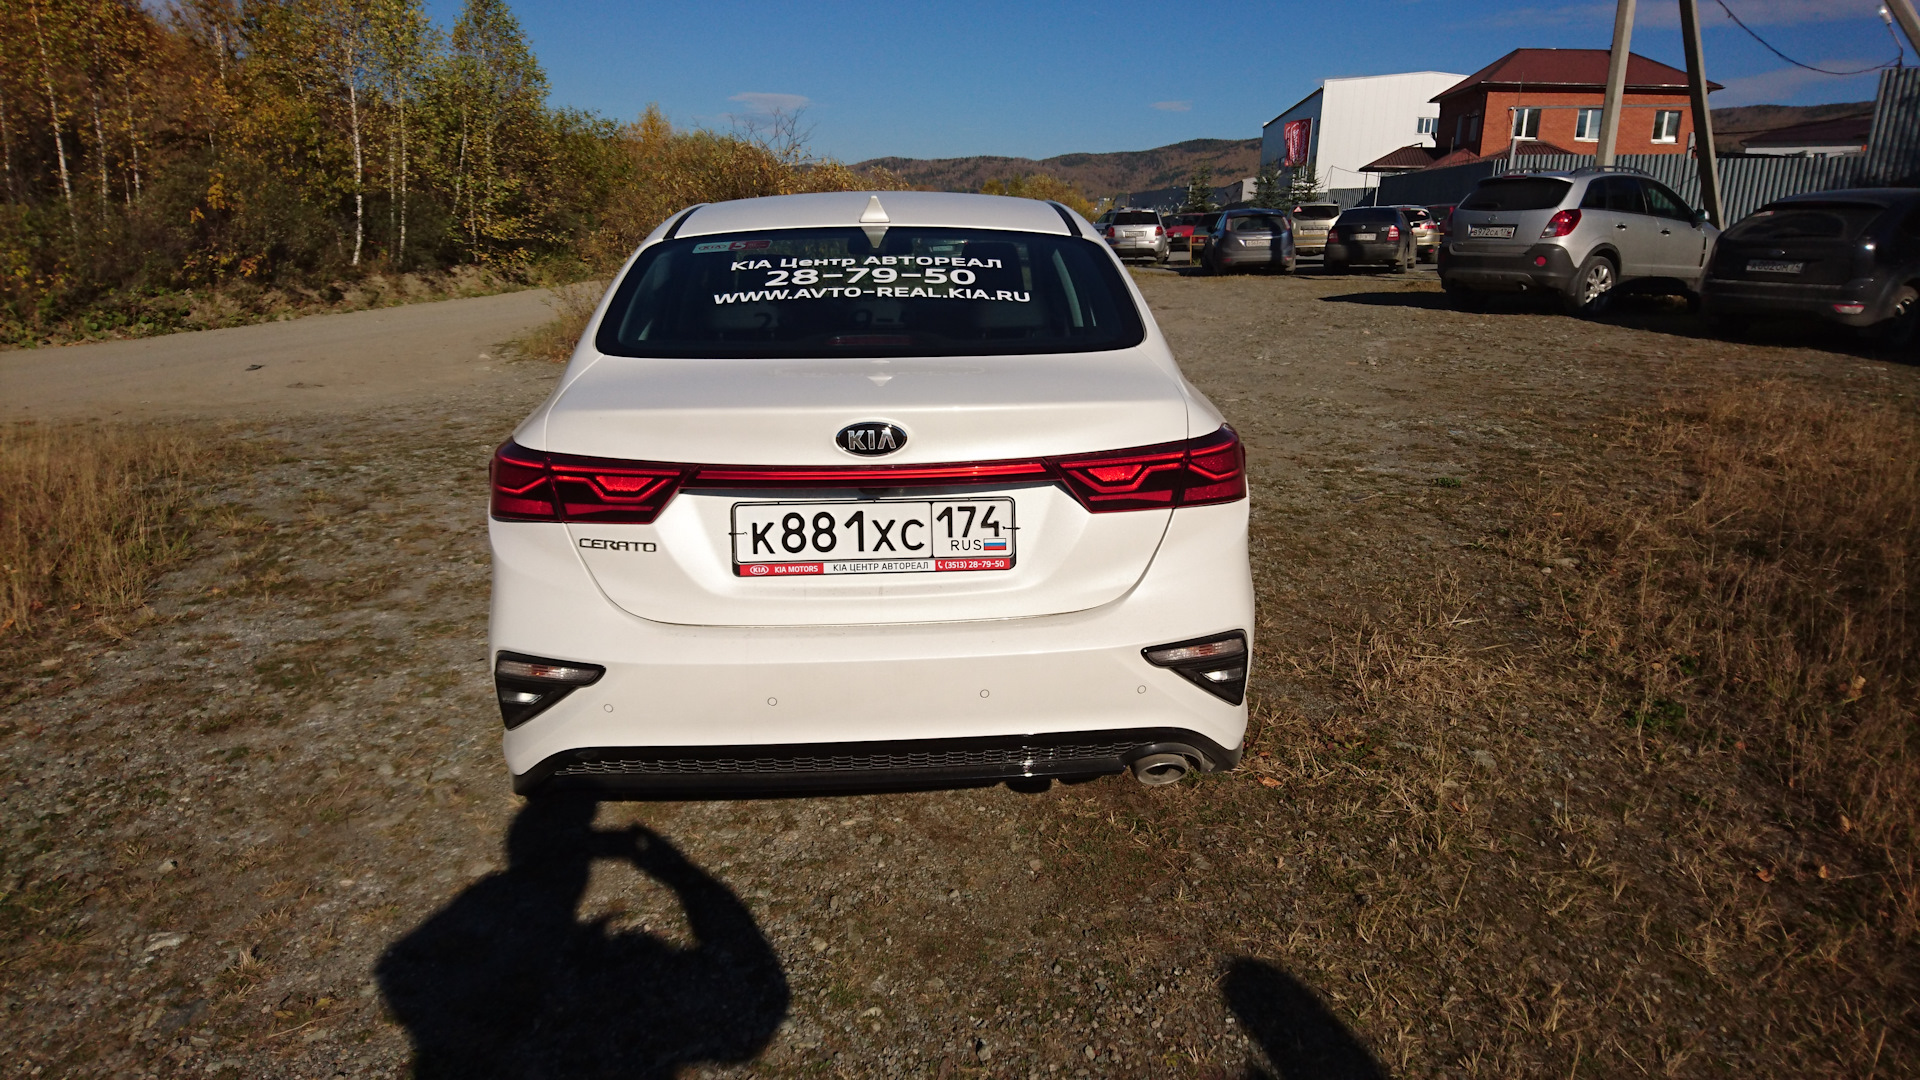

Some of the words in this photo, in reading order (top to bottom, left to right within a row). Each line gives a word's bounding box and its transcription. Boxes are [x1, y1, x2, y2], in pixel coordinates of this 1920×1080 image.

[731, 260, 772, 271] KIA
[780, 258, 856, 268] Центр
[863, 256, 1002, 269] АВТОРЕАЛ
[765, 267, 976, 286] 28-79-50
[714, 287, 1030, 304] WWW.AVTO-REAL.KIA.RU
[848, 429, 897, 450] KIA
[752, 510, 925, 554] К881ХС
[936, 505, 999, 538] 174
[579, 537, 657, 553] CERATO
[950, 540, 982, 551] RUS
[788, 565, 818, 573] MOTORS
[833, 563, 847, 571] KIA
[849, 563, 879, 571] ЦЕНТР
[881, 562, 929, 571] АВТОРЕАЛ
[945, 560, 967, 569] (3513)
[968, 560, 1005, 568] 28-79-50
